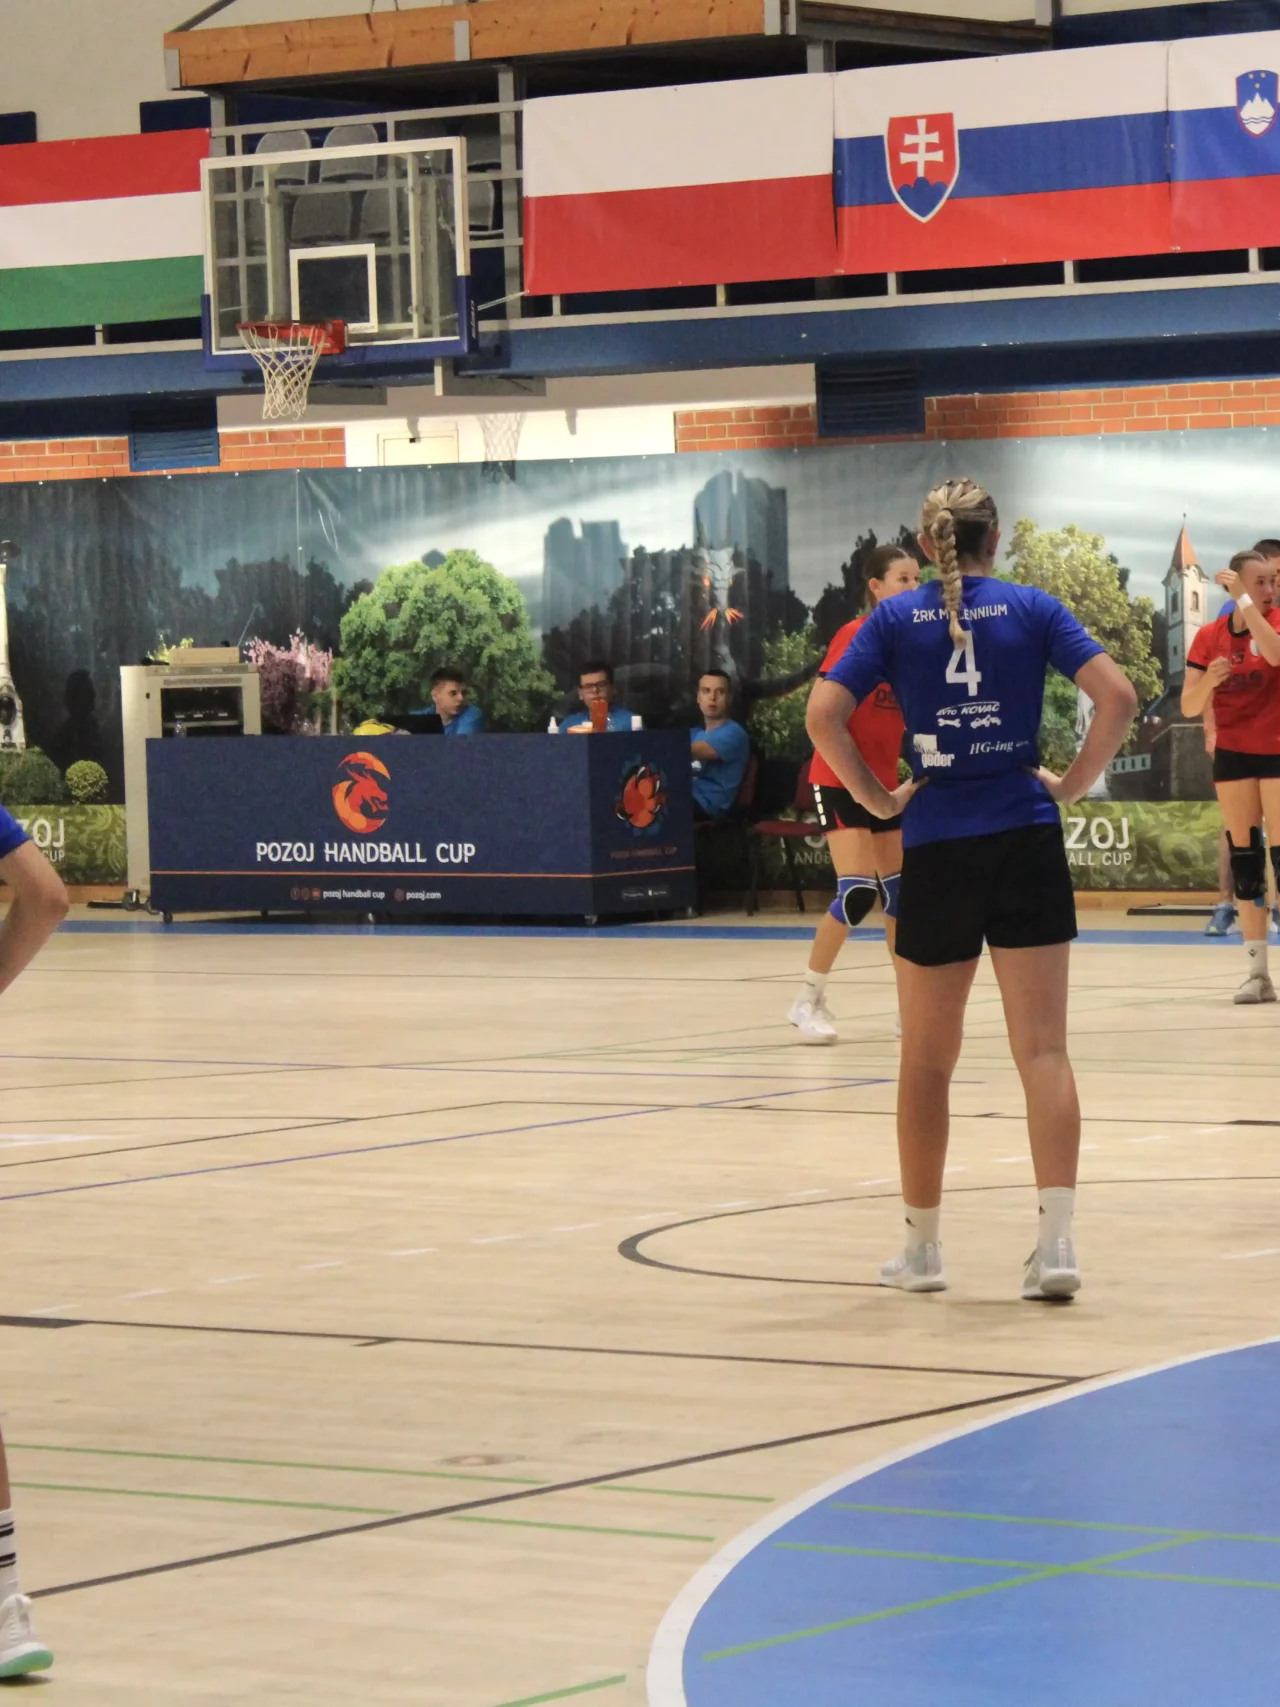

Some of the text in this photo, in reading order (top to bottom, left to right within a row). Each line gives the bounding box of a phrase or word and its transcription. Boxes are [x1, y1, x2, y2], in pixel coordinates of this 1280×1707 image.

[912, 604, 1008, 623] ŽRK MENNIUM
[945, 630, 982, 697] 4
[970, 740, 1014, 755] HG-ing
[256, 842, 476, 864] POZOJ HANDBALL CUP
[1102, 852, 1132, 866] CUP
[323, 889, 386, 899] pozoj handball cup
[406, 891, 442, 901] pozoj.com
